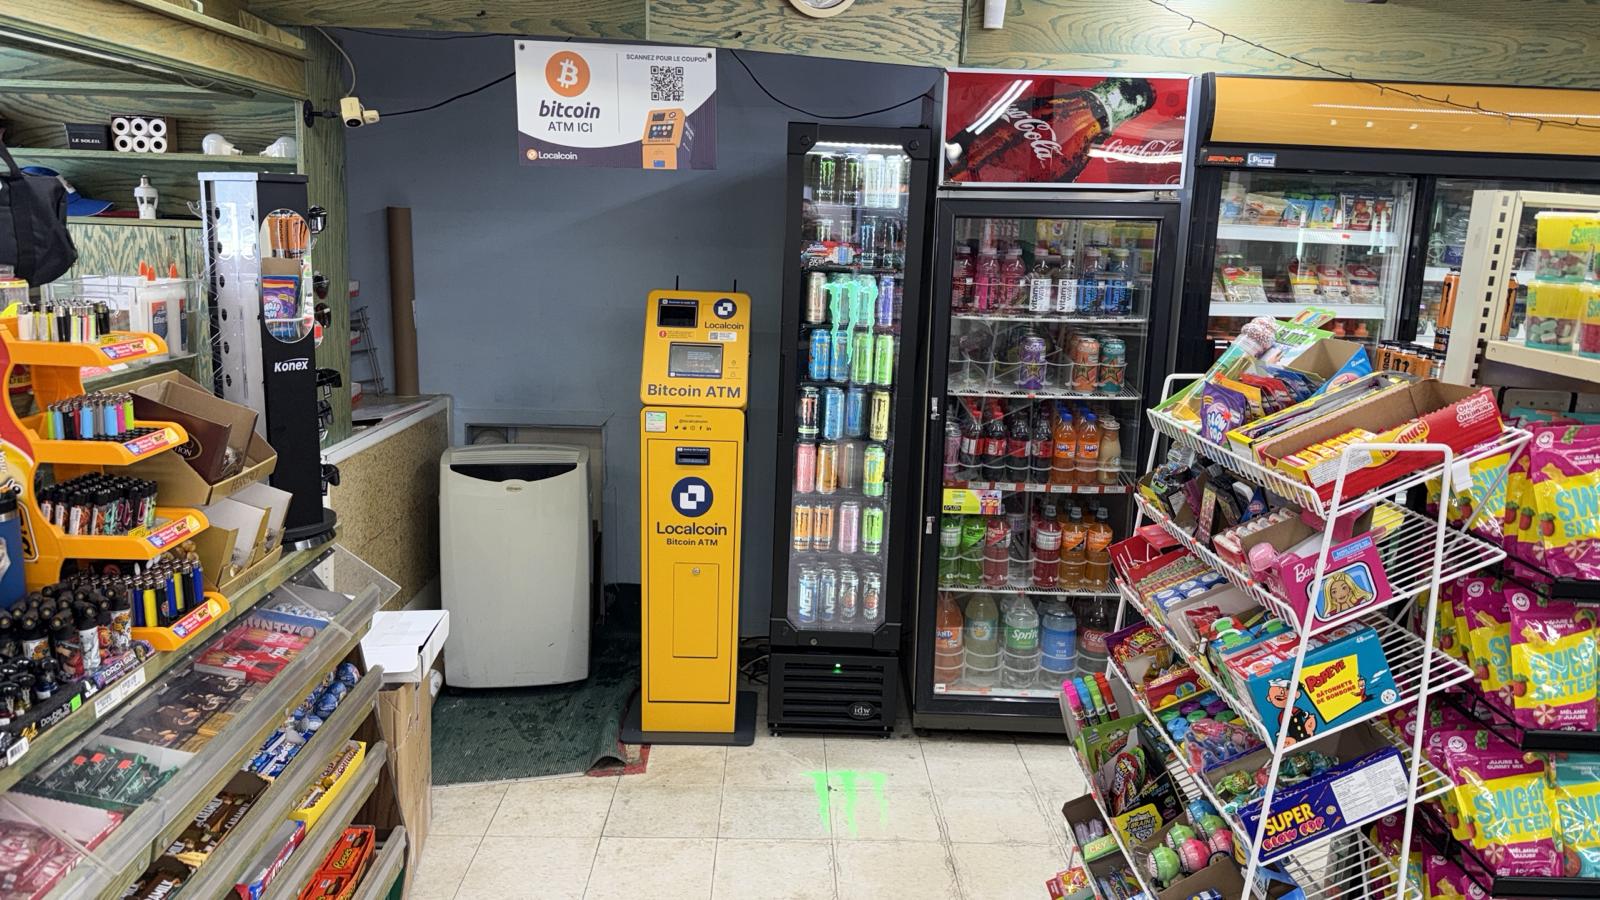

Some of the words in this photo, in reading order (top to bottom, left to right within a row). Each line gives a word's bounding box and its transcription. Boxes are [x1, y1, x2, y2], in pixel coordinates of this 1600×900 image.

[682, 55, 707, 63] COUPON
[539, 100, 600, 119] bitcoin
[548, 121, 574, 133] ATM
[577, 121, 593, 133] ICI
[538, 150, 578, 161] Localcoin
[1103, 139, 1183, 164] Coca-Cola
[704, 321, 744, 331] Localcoin
[274, 359, 309, 373] Konex
[647, 383, 701, 397] Bitcoin
[705, 386, 741, 398] ATM
[656, 521, 728, 536] Localcoin
[666, 538, 696, 546] Bitcoin
[697, 538, 718, 546] ATM
[102, 660, 124, 678] TORCH
[1305, 658, 1347, 693] POPEYE
[1316, 697, 1325, 705] DE
[1325, 684, 1356, 702] BONBONS
[854, 705, 871, 714] idw
[1265, 802, 1315, 836] SUPER
[1262, 827, 1298, 851] BLOW
[1299, 816, 1325, 837] POP
